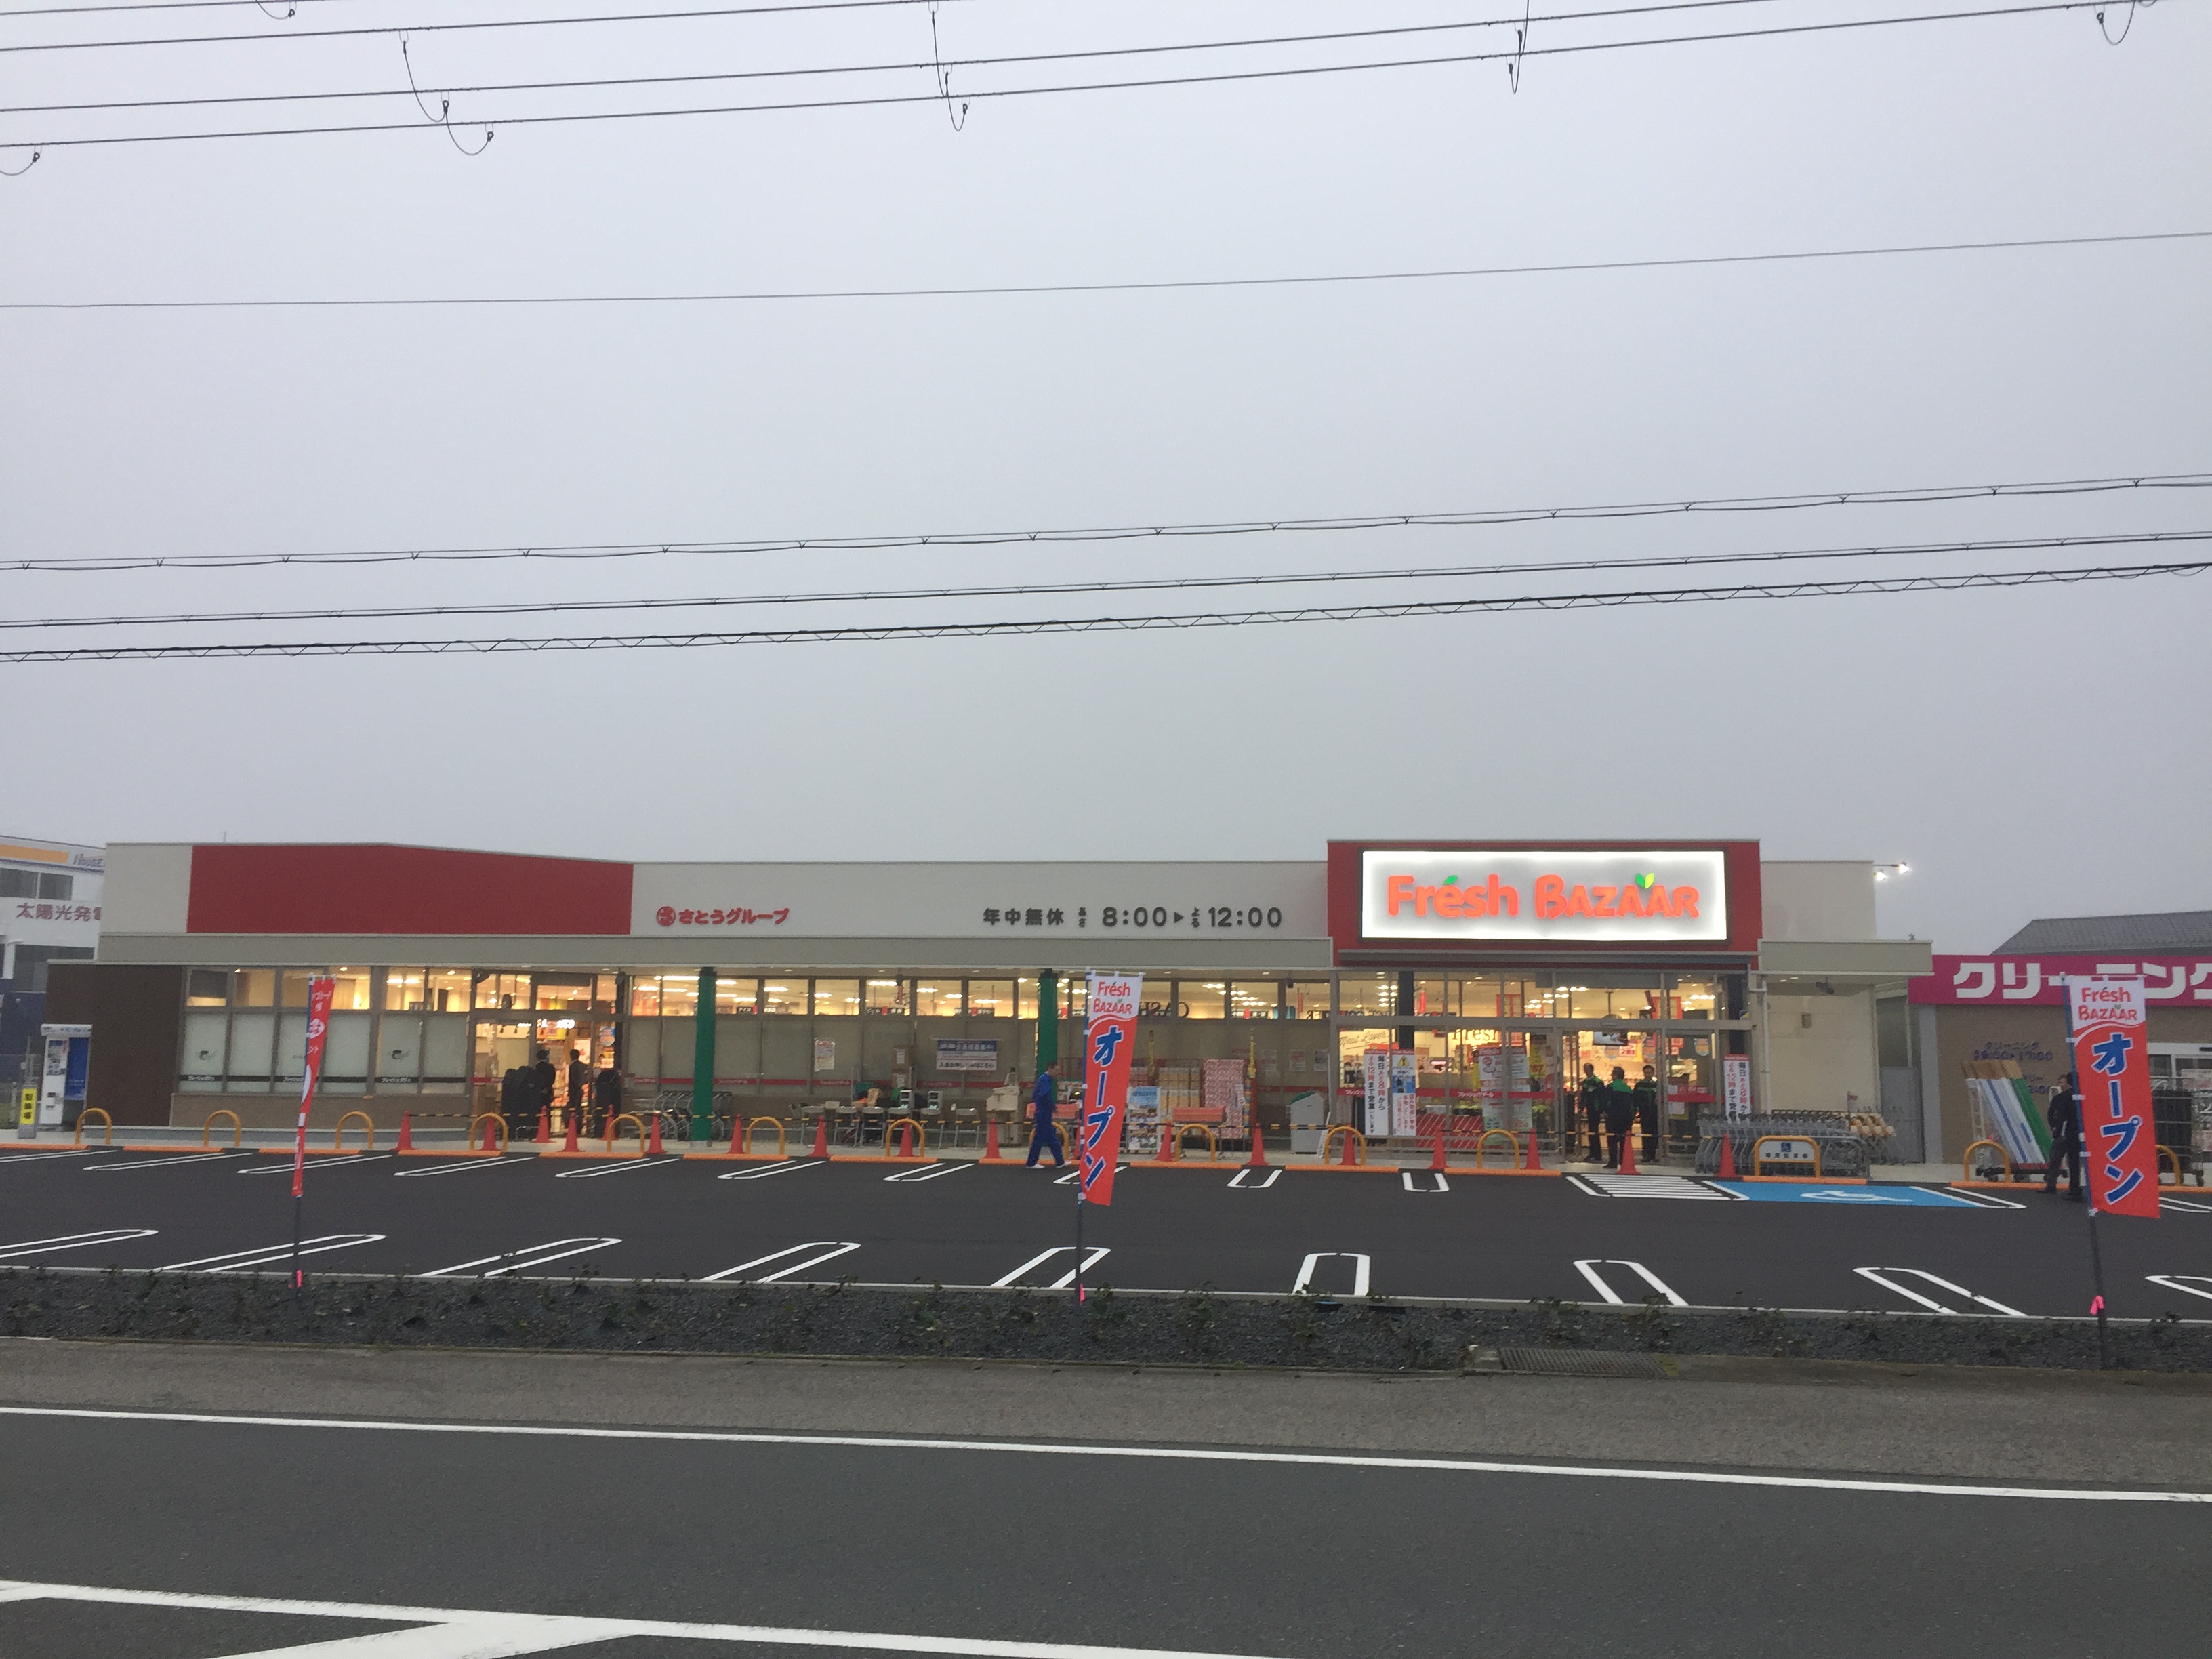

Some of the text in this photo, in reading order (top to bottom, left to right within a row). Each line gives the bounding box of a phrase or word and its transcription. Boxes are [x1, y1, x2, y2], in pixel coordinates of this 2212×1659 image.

[1534, 873, 1700, 919] BAZAAR
[678, 907, 790, 925] さとうグループ
[983, 907, 1064, 926] 年中無休
[1103, 907, 1167, 927] 8:00
[1208, 907, 1282, 928] 12:00
[1092, 998, 1132, 1015] BAZAAR
[2078, 1004, 2137, 1021] BAZAAR
[1085, 1025, 1124, 1191] オープン
[2091, 1032, 2144, 1205] オープン
